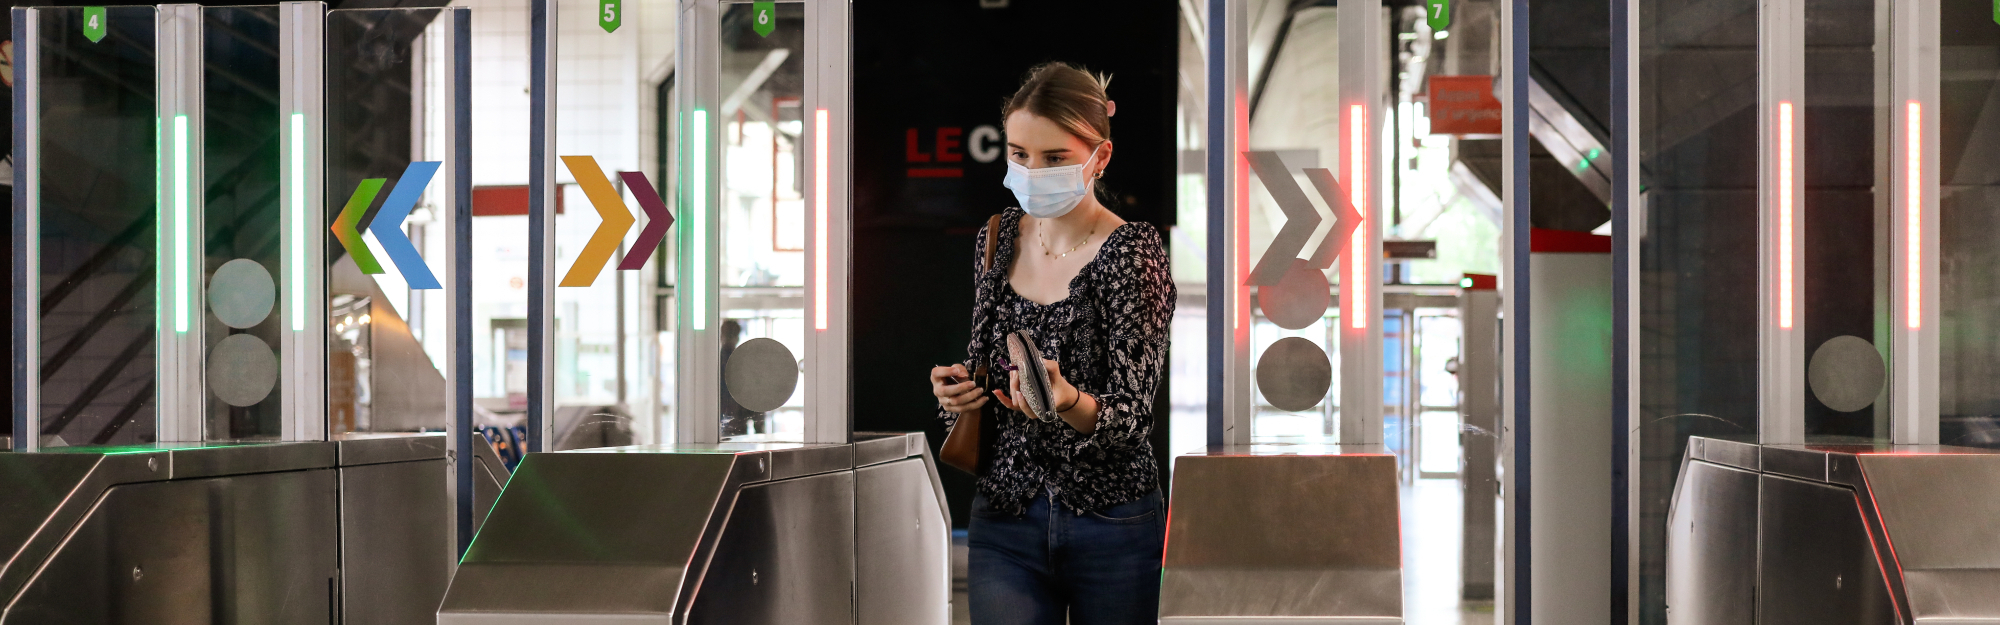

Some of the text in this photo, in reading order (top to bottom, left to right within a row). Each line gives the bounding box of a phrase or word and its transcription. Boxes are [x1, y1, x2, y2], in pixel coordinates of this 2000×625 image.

[603, 3, 616, 22] 5
[758, 9, 769, 25] 6
[1432, 3, 1443, 19] 7
[88, 14, 99, 30] 4
